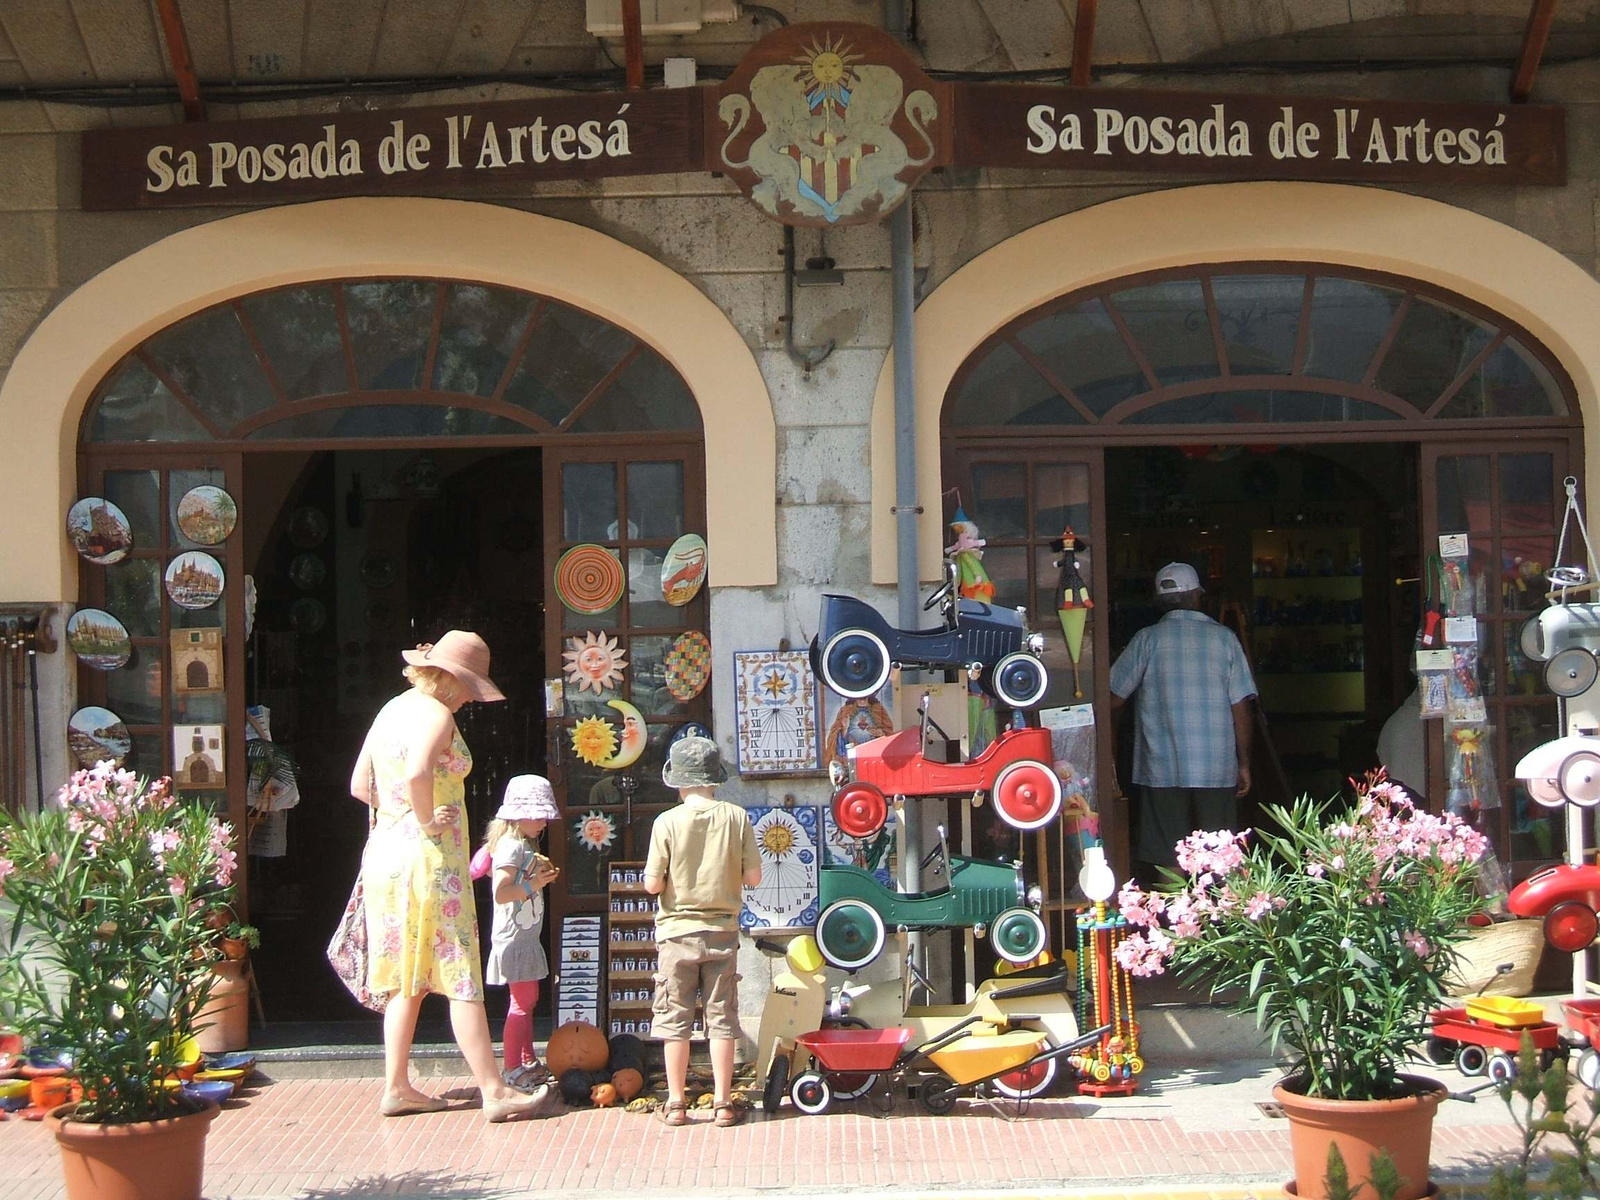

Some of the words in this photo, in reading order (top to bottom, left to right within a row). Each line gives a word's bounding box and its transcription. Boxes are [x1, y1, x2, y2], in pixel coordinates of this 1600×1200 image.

[146, 145, 200, 193] Sa
[208, 124, 364, 188] Posada
[377, 119, 431, 175] de
[445, 103, 632, 169] l'Artesá
[1026, 104, 1084, 154] Sa
[1093, 103, 1253, 157] Posada
[1268, 106, 1321, 160] de
[1332, 108, 1507, 164] l'Artesá
[751, 719, 761, 728] VII
[795, 707, 803, 715] VI
